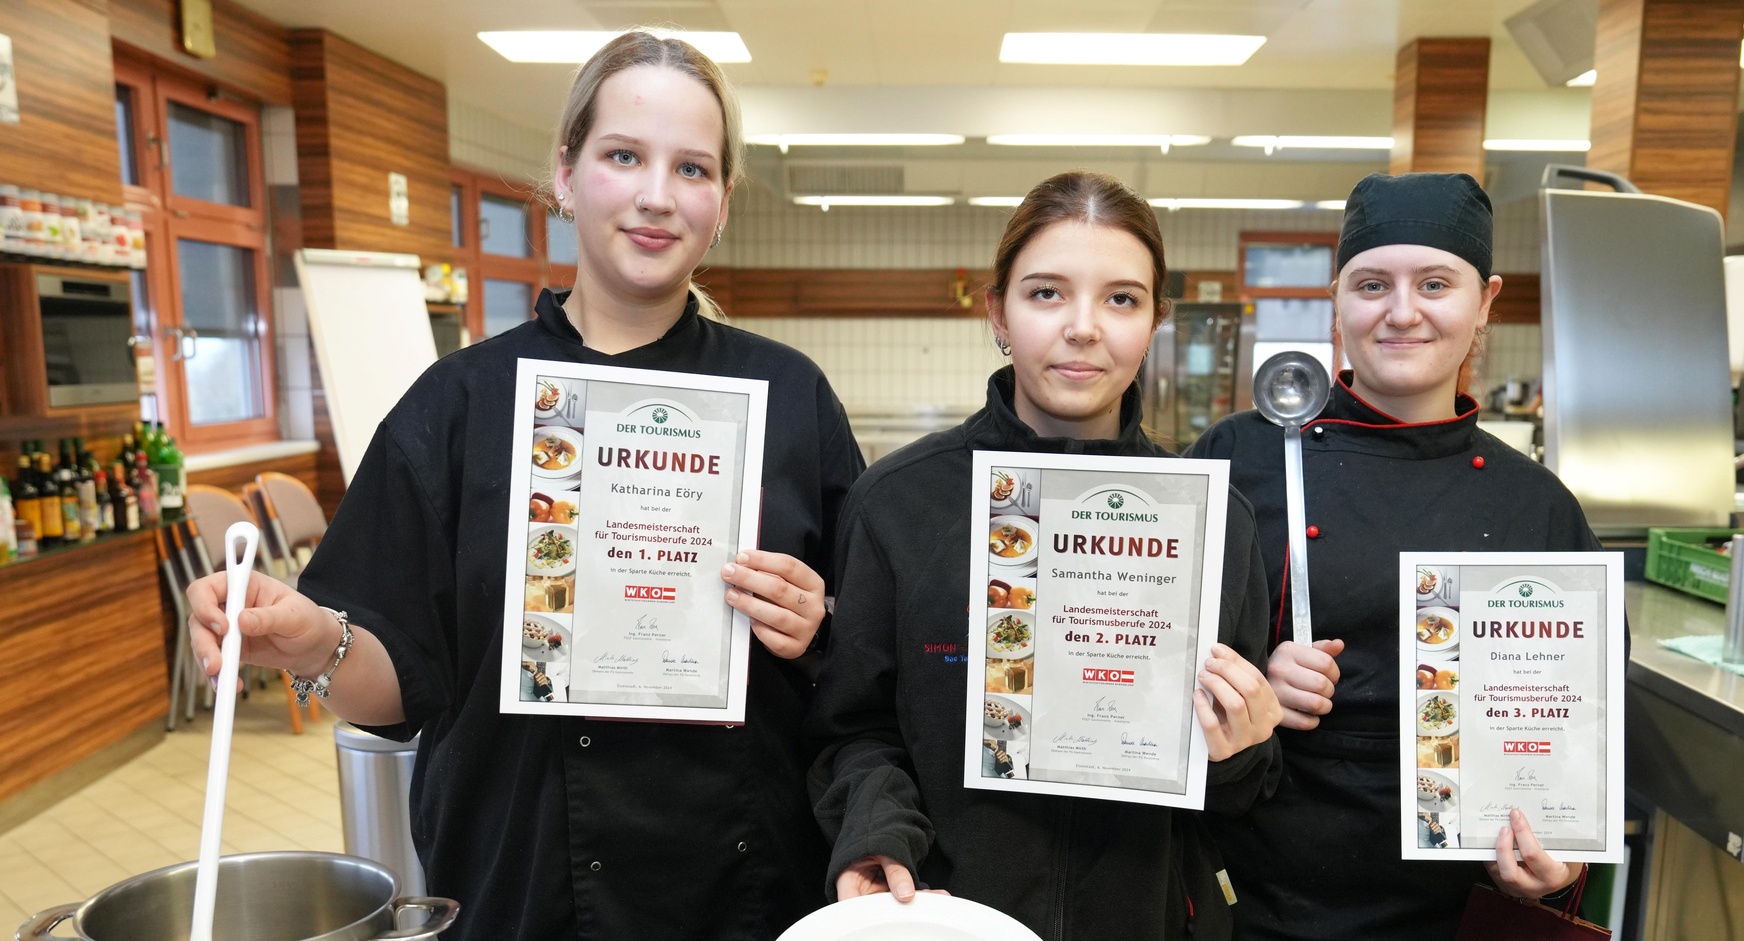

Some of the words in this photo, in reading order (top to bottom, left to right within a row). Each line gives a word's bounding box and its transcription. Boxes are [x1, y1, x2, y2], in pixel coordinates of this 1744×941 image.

[616, 424, 637, 434] DER
[640, 426, 701, 438] TOURISMUS
[598, 446, 721, 475] URKUNDE
[611, 483, 671, 497] Katharina
[676, 488, 703, 501] Eöry
[1071, 510, 1092, 520] DER
[1095, 511, 1158, 522] TOURISMUS
[606, 520, 700, 534] Landesmeisterschaft
[594, 531, 609, 539] für
[611, 532, 687, 545] Tourismusberufe
[690, 537, 712, 546] 2024
[1053, 534, 1179, 558] URKUNDE
[607, 547, 632, 559] den
[639, 549, 651, 560] 1.
[657, 550, 698, 563] PLATZ
[629, 568, 647, 576] Sparte
[1051, 568, 1112, 581] Samantha
[1117, 571, 1177, 586] Weninger
[625, 585, 663, 599] WKO
[1488, 600, 1506, 608] DER
[1509, 600, 1564, 608] TOURISMUS
[1063, 605, 1159, 618] Landesmeisterschaft
[1052, 615, 1066, 624] für
[1069, 616, 1146, 628] Tourismusberufe
[1149, 621, 1172, 629] 2024
[1473, 621, 1585, 639] URKUNDE
[1065, 631, 1090, 642] den
[1096, 633, 1109, 644] 2.
[1115, 634, 1157, 647] PLATZ
[923, 643, 957, 653] SIMON
[1086, 651, 1105, 659] Sparte
[1106, 652, 1124, 660] Küche
[1490, 652, 1521, 661] Diana
[1525, 652, 1565, 661] Lehner
[1083, 668, 1121, 682] WKO
[1483, 684, 1570, 692] Landesmeisterschaft
[1474, 694, 1487, 702] für
[1488, 694, 1558, 702] Tourismusberufe
[1561, 695, 1582, 703] 2024
[1486, 707, 1509, 718] den
[1514, 708, 1526, 718] 3.
[1531, 708, 1569, 718] PLATZ
[1504, 741, 1538, 753] WKO
